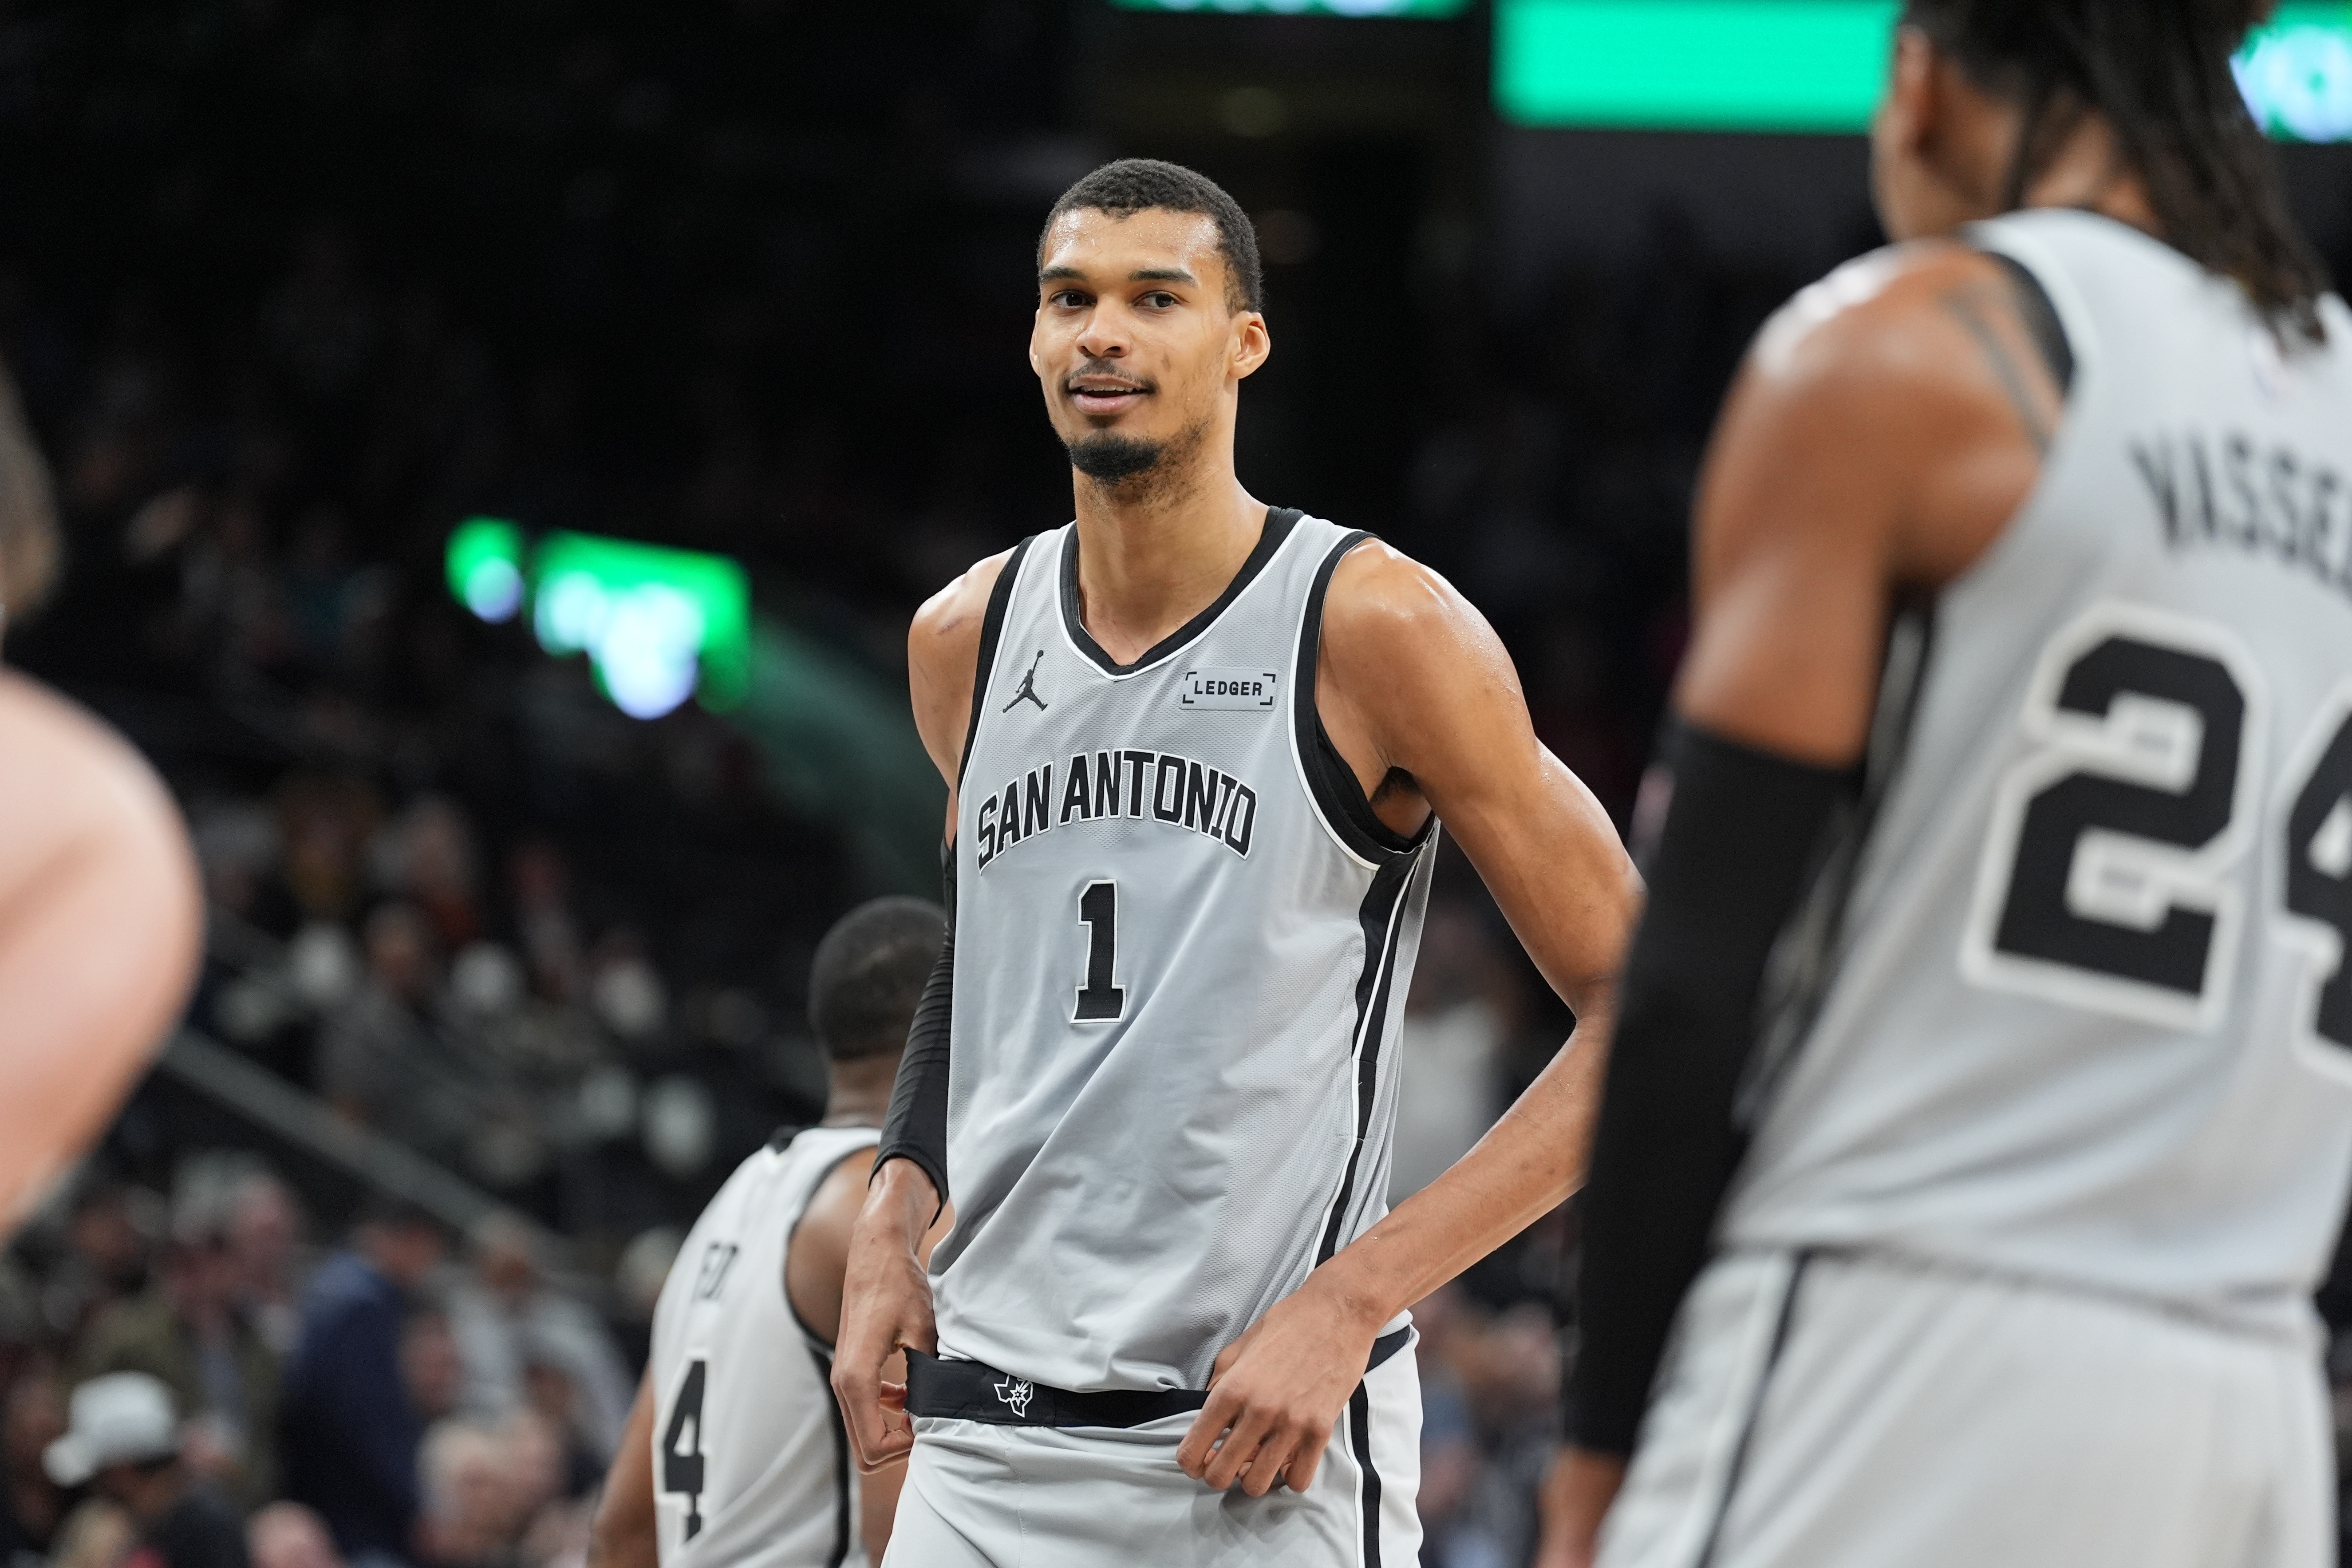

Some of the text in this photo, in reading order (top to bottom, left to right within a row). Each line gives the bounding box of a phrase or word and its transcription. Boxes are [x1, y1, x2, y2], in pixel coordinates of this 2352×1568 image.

[2125, 421, 2352, 609] VASSE
[1194, 680, 1263, 697] LEDGER
[977, 748, 1258, 876] SAN ANTONIO
[1977, 619, 2352, 1070] 2
[1070, 879, 1126, 1023] 1
[659, 1355, 708, 1546] 4
